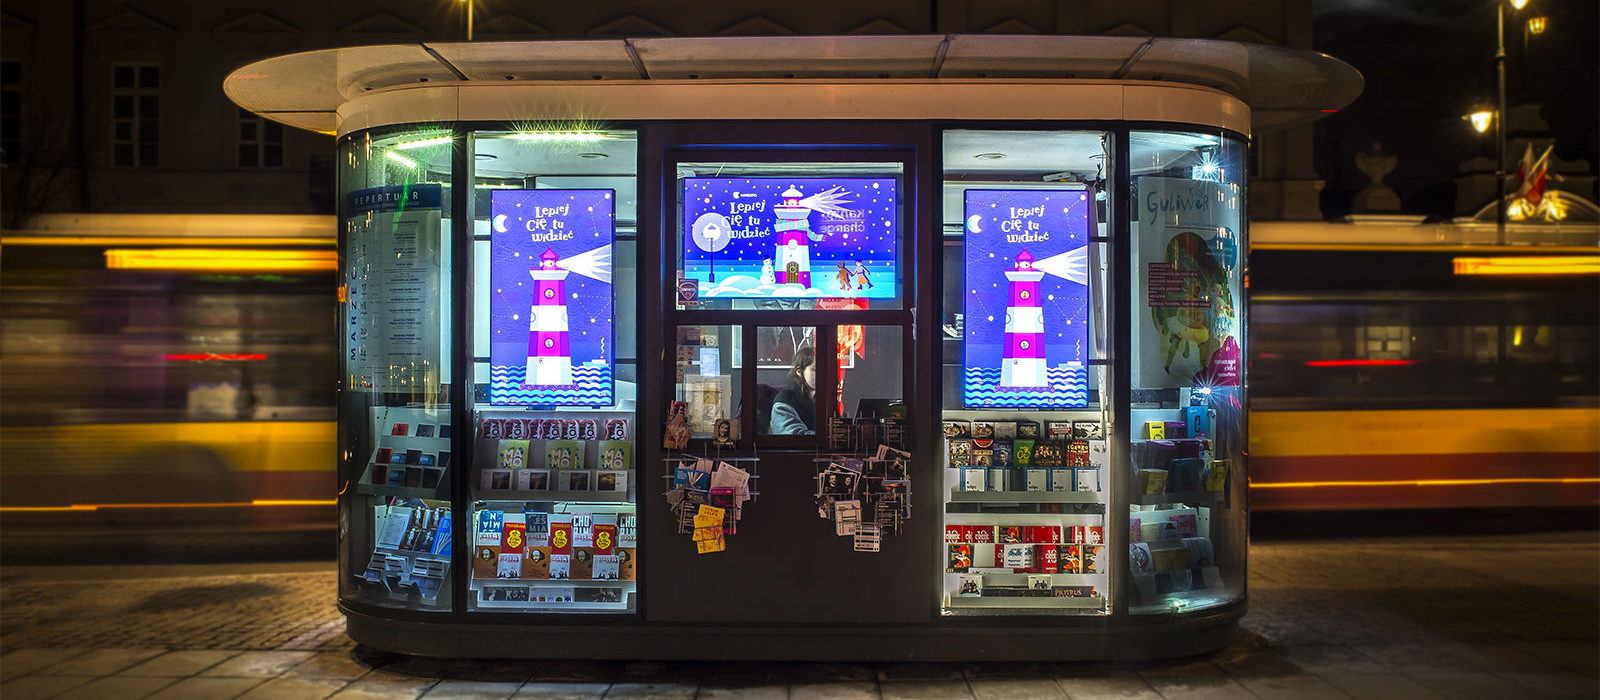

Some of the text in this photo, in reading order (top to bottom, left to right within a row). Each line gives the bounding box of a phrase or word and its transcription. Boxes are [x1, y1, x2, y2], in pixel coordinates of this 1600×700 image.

[535, 203, 570, 218] Lepiej
[730, 199, 766, 214] Lepiej
[1010, 204, 1045, 219] Lepiej
[526, 219, 564, 232] Cię tu
[721, 214, 760, 227] Cię tu
[1001, 219, 1039, 232] Cię tu
[531, 229, 574, 242] widzieć
[727, 226, 771, 239] widzieć
[1006, 230, 1050, 243] widzieć
